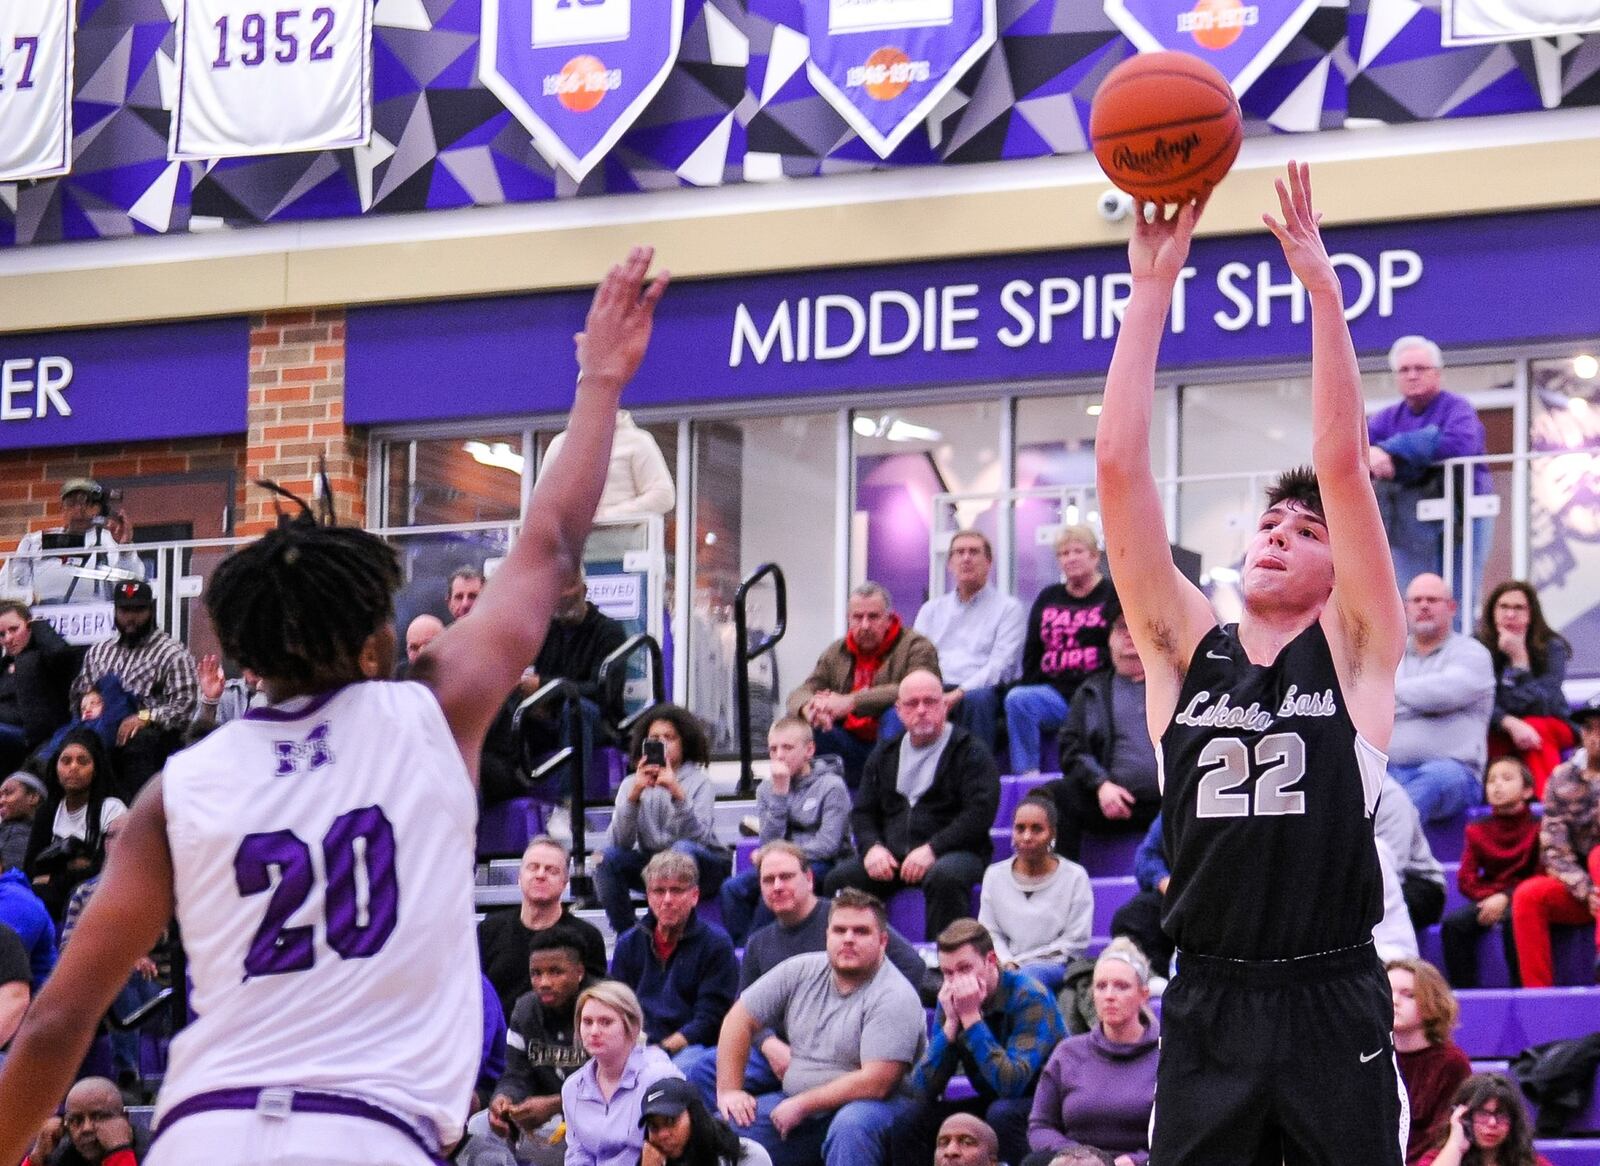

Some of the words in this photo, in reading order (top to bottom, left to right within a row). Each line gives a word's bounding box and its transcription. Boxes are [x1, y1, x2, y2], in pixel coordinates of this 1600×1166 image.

[212, 7, 336, 69] 1952
[728, 284, 980, 368] MIDDIE
[997, 266, 1197, 348] SPIRT
[1214, 250, 1424, 331] SHOP
[1277, 684, 1337, 718] East
[1196, 732, 1306, 818] 22
[233, 803, 399, 984] 20
